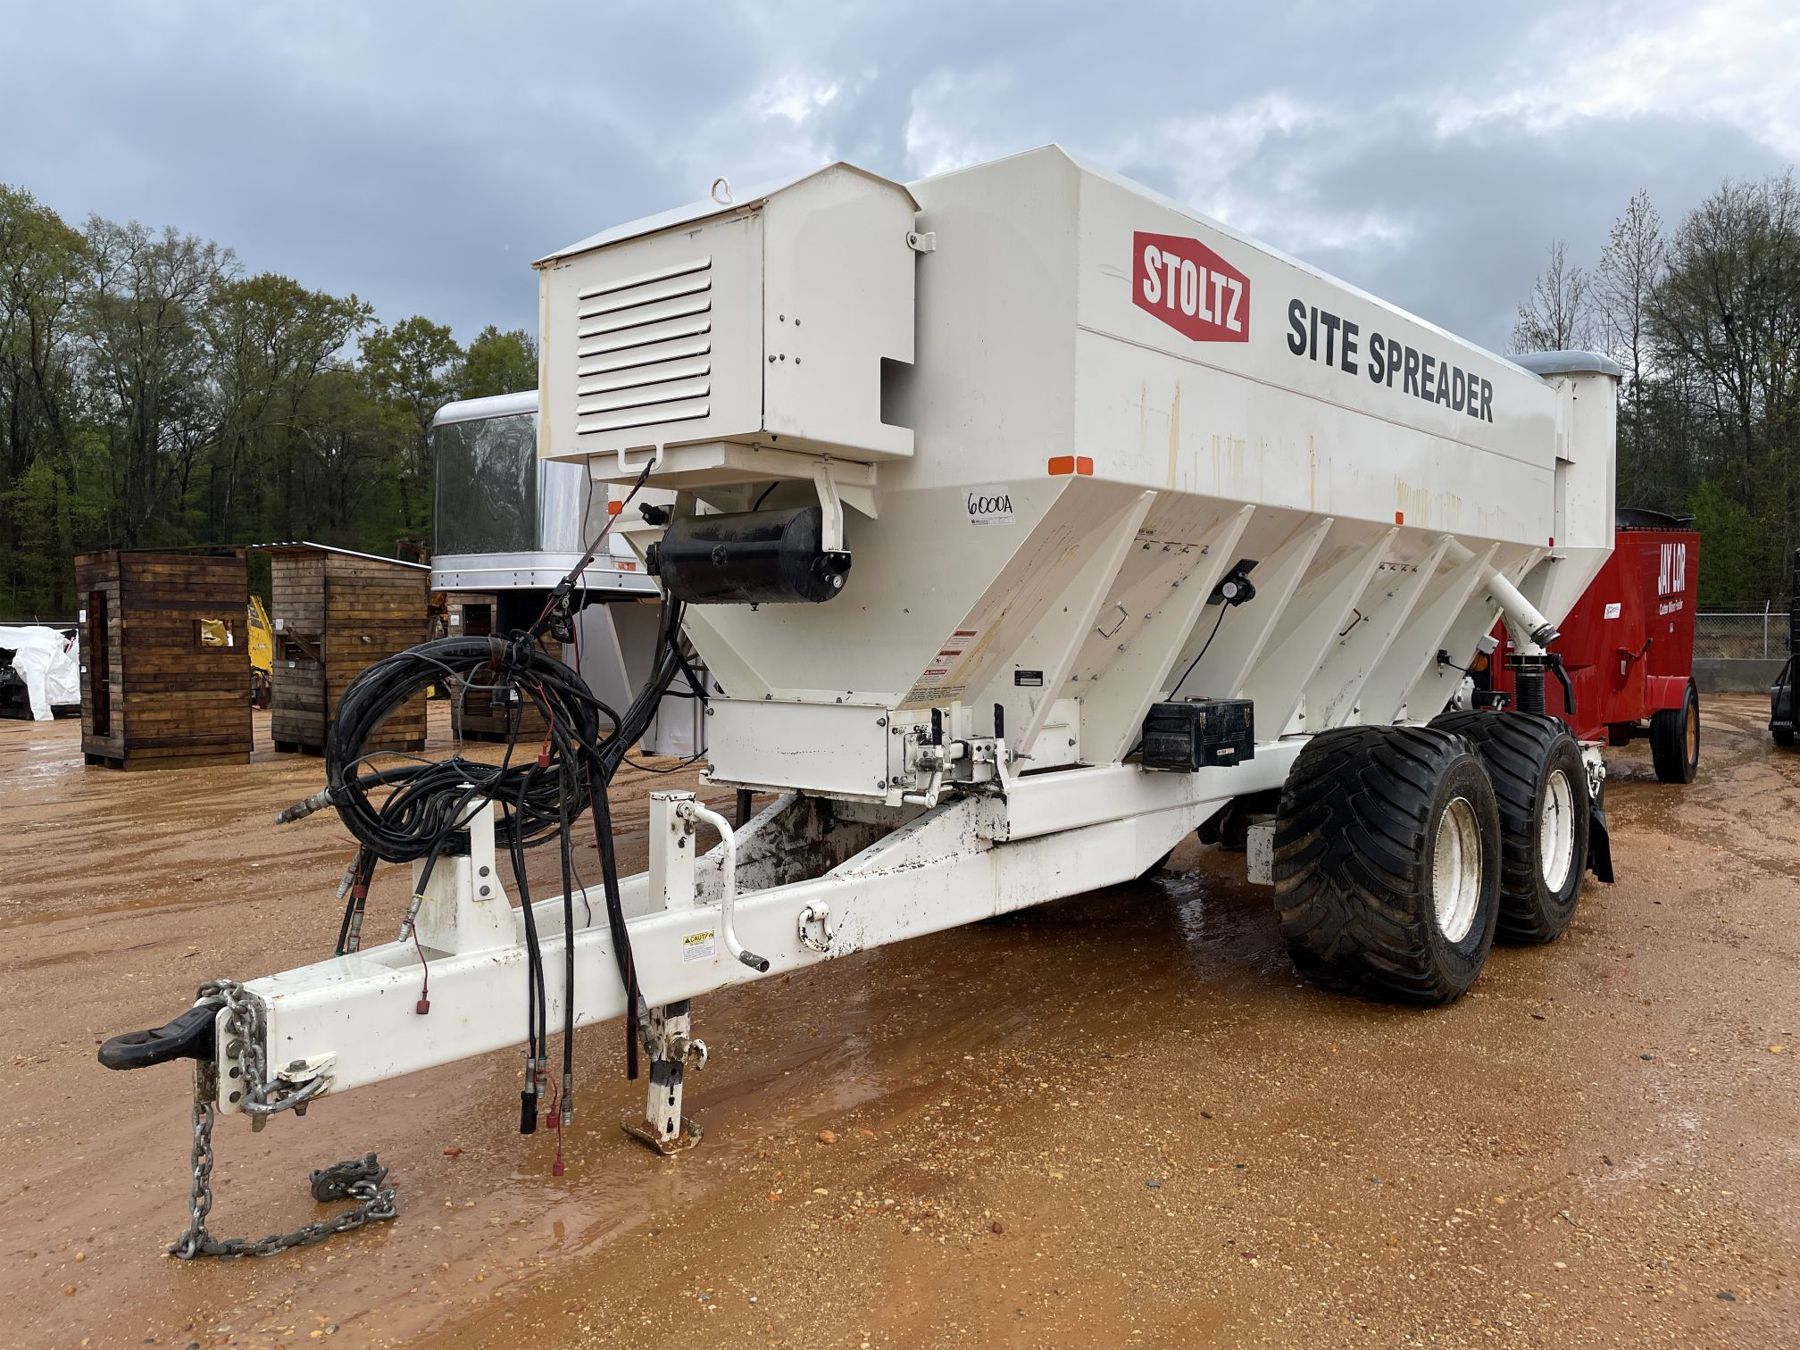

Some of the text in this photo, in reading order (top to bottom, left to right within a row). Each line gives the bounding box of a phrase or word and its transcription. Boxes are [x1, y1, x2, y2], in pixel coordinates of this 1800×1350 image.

[1143, 244, 1243, 333] STOLTZ
[1287, 298, 1493, 423] SITE SPREADER
[967, 492, 1013, 515] 6000A
